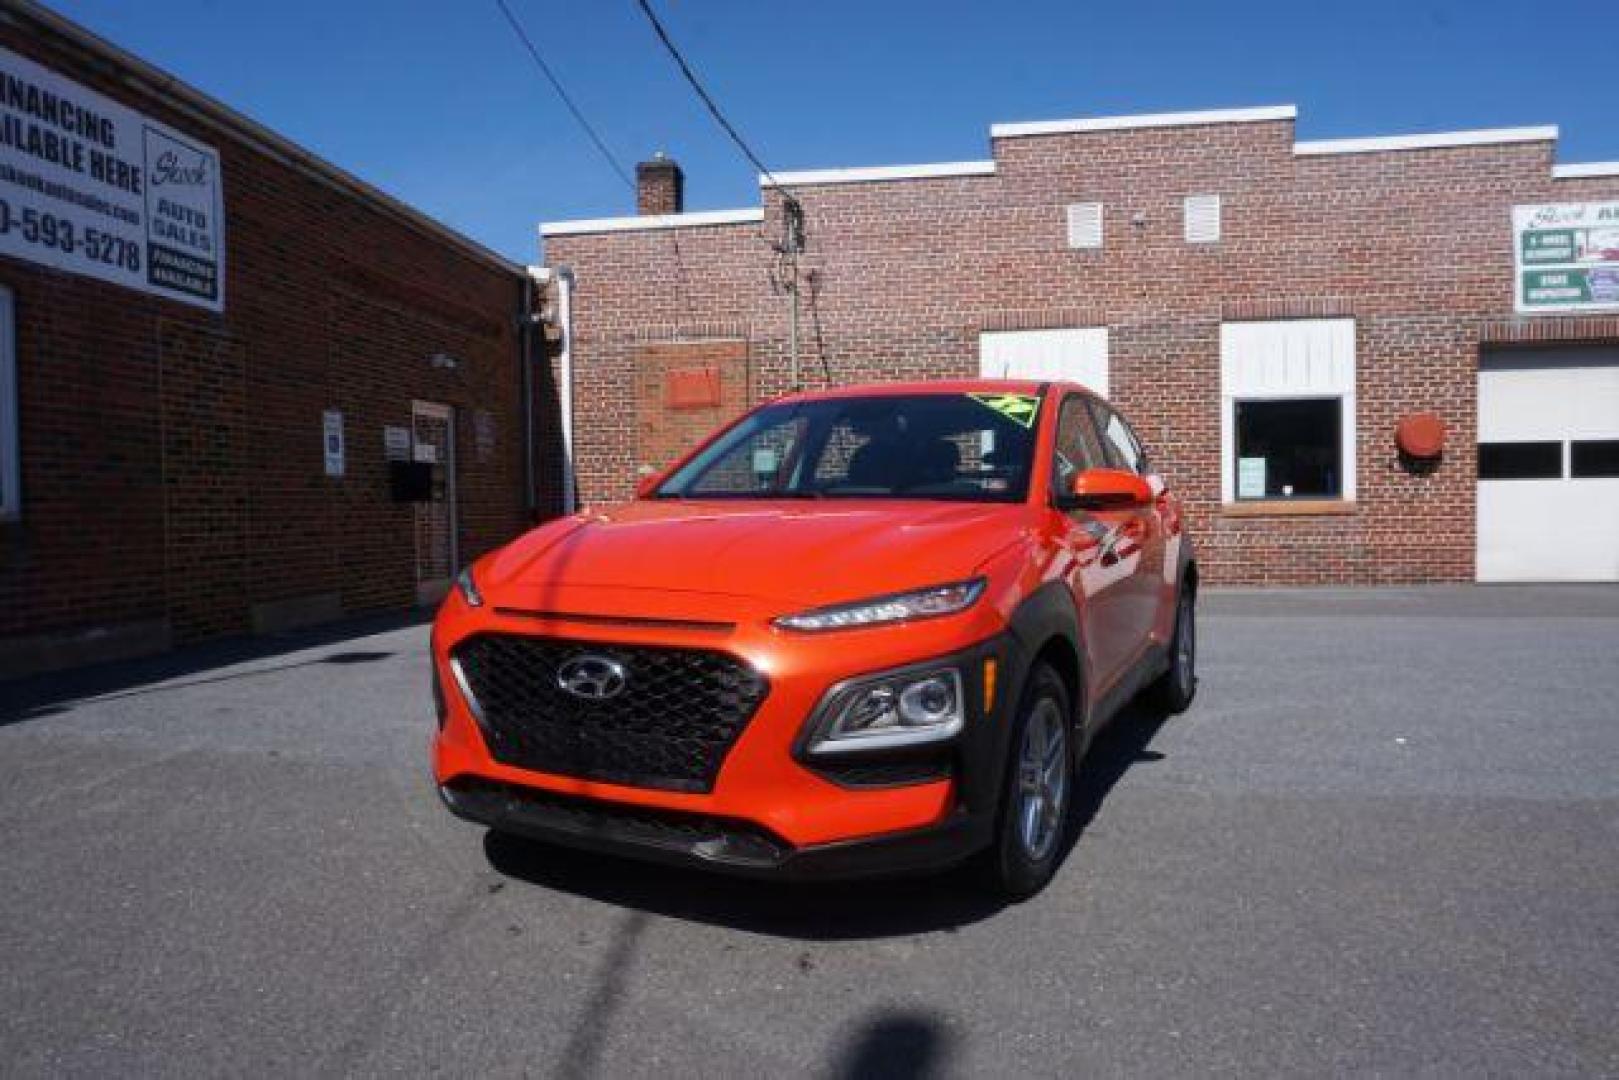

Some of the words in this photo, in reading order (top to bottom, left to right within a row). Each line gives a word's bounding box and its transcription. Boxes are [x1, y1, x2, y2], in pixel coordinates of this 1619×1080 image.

[0, 112, 84, 172] ILABLE
[91, 149, 142, 195] HERE
[157, 199, 206, 228] AUTO
